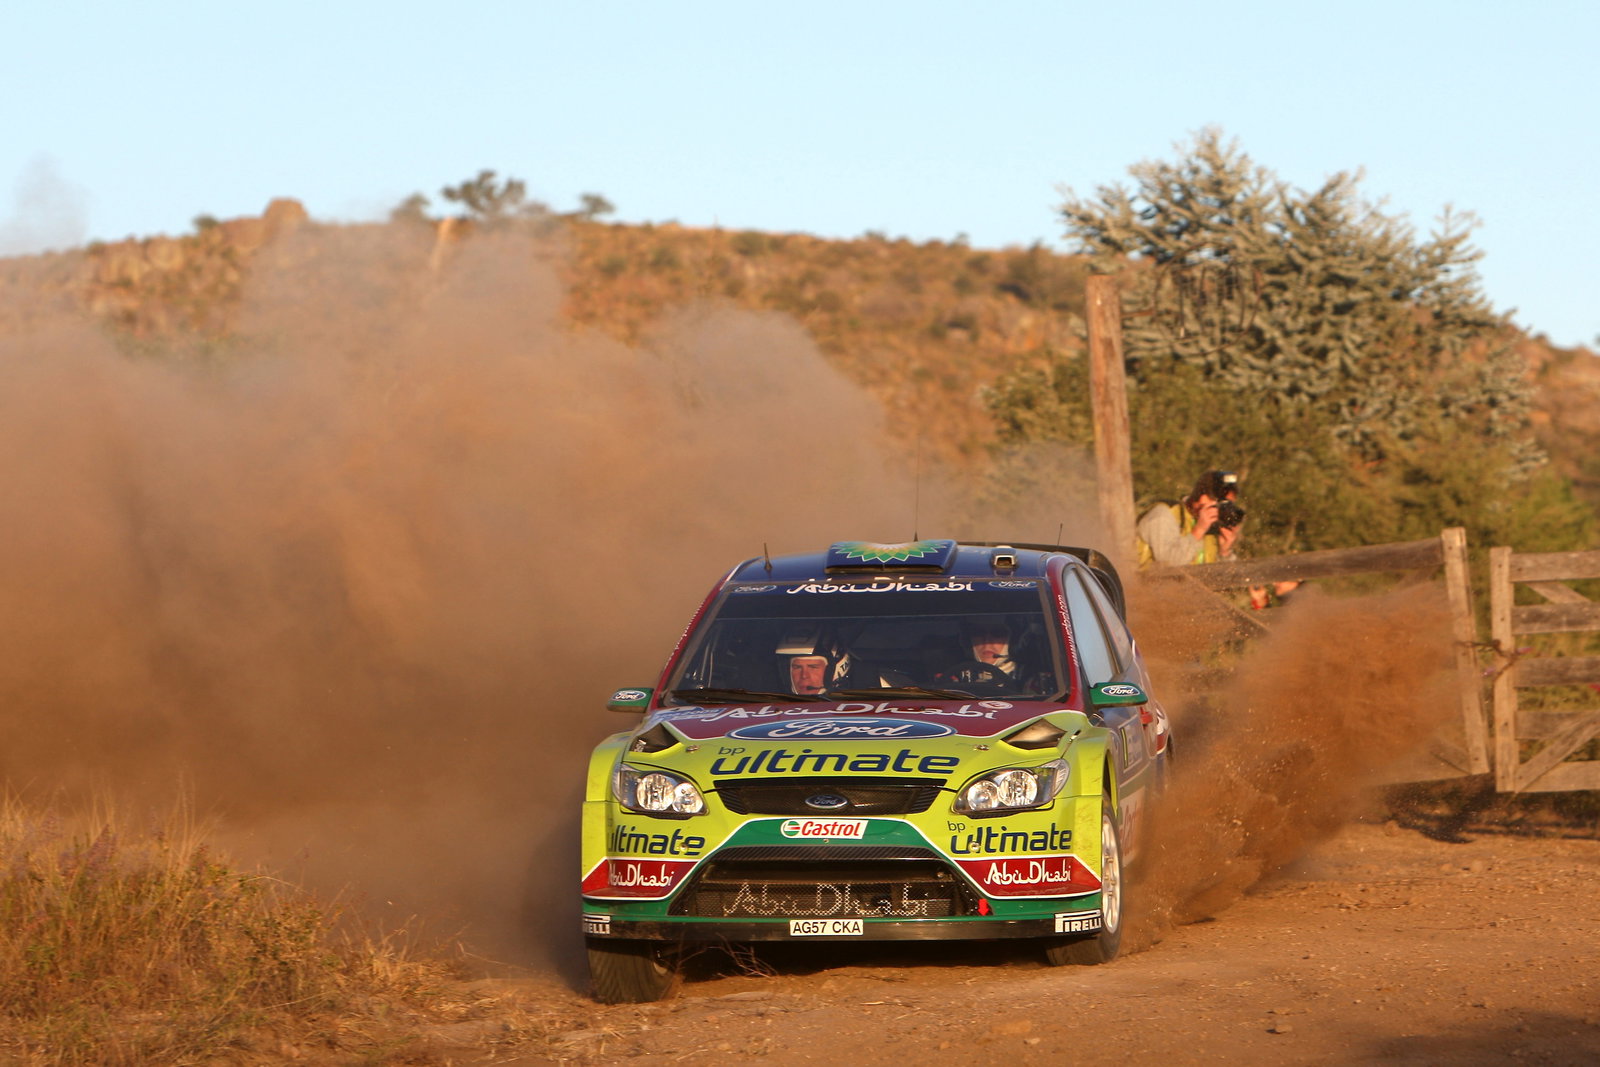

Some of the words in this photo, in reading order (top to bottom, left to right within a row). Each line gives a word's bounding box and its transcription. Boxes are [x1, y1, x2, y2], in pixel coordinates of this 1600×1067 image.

[615, 691, 640, 700] Ford
[1109, 686, 1134, 694] Ford
[768, 720, 913, 736] Ford
[718, 746, 746, 756] bp
[710, 749, 960, 775] ultimate
[801, 821, 861, 836] Castrol
[947, 821, 966, 831] bp
[951, 823, 1072, 854] ultimate
[793, 922, 827, 933] AG57
[832, 922, 860, 933] CKA
